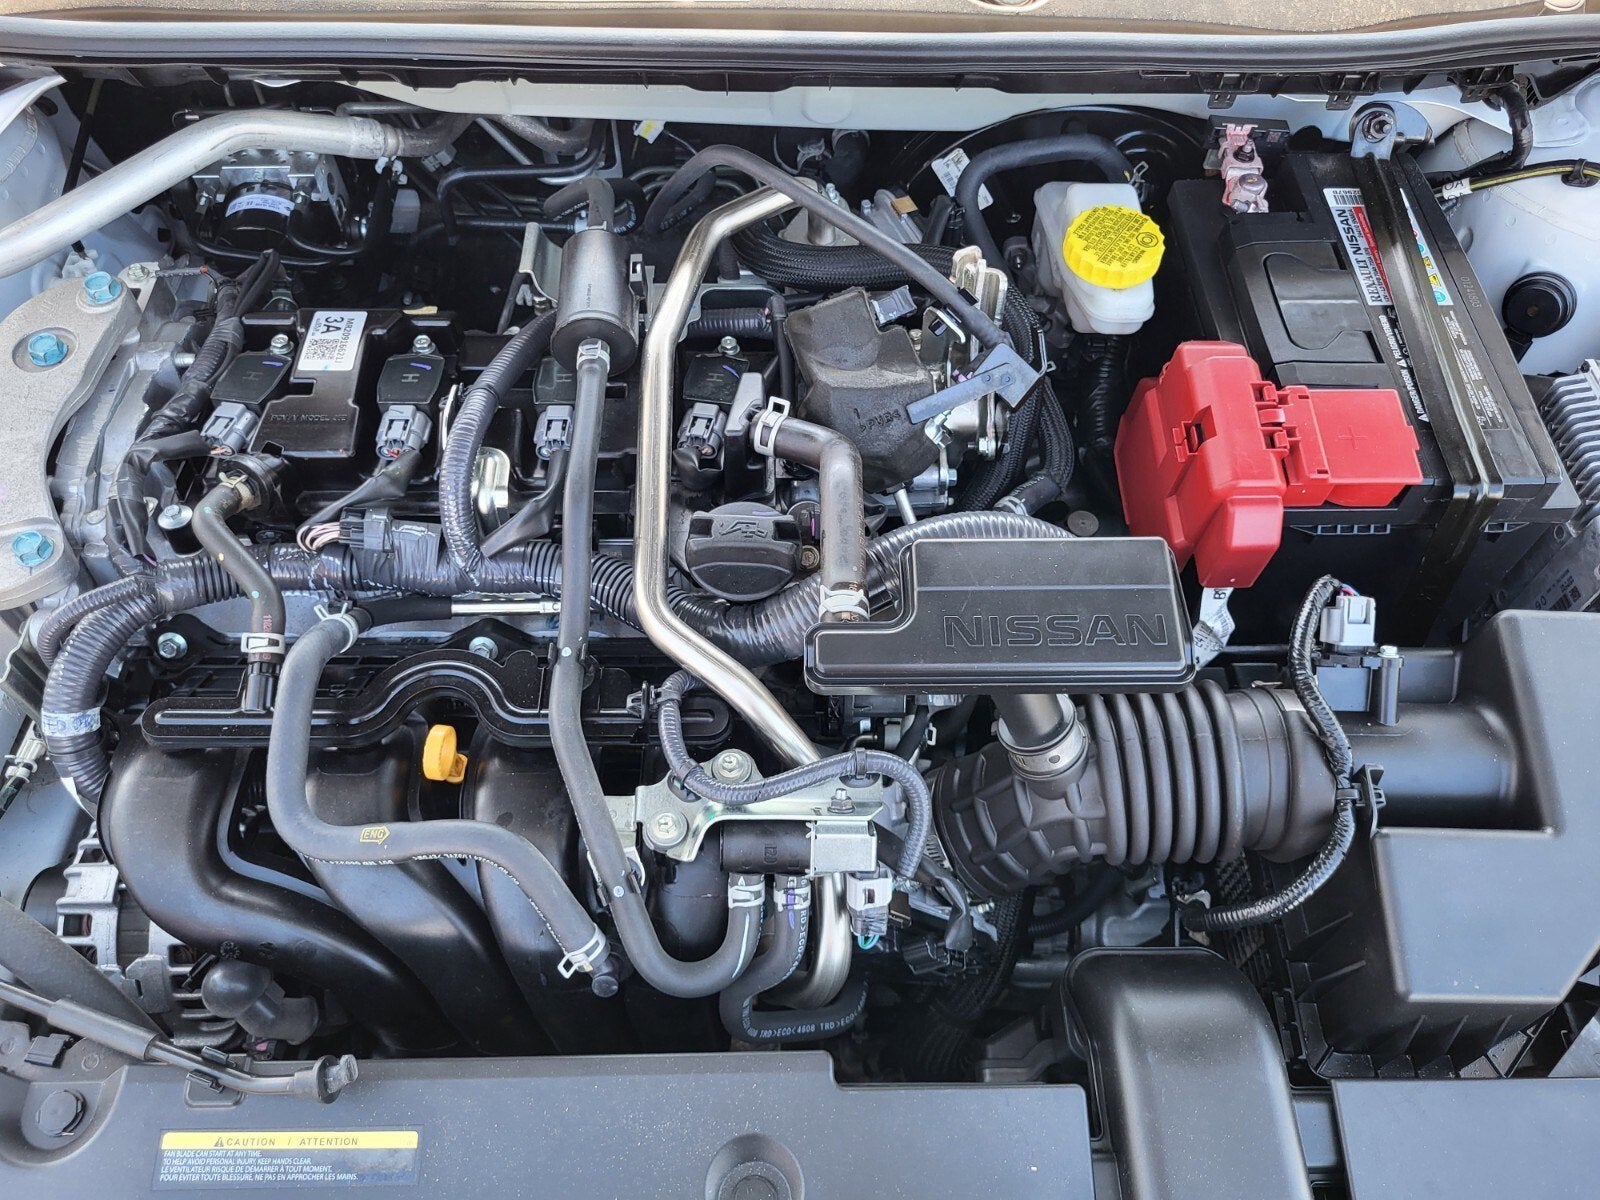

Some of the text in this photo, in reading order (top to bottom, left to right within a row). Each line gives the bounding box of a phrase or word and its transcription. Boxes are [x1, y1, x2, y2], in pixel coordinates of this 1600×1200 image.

[1335, 209, 1382, 302] RENAULT NISSAN
[321, 317, 344, 334] 3A
[943, 614, 1168, 647] NISSAN
[363, 829, 384, 840] ENG
[226, 1138, 276, 1147] CAUTION
[299, 1137, 358, 1146] ATTENTION
[244, 1165, 278, 1173] DÉMARRER
[160, 1173, 178, 1181] POUR
[201, 1173, 221, 1181] TOUTE
[255, 1173, 263, 1181] NE
[264, 1173, 277, 1181] PAS
[278, 1173, 286, 1181] EN
[287, 1173, 324, 1181] APPROCHER
[325, 1173, 335, 1181] LES
[337, 1173, 358, 1181] MAINS.
